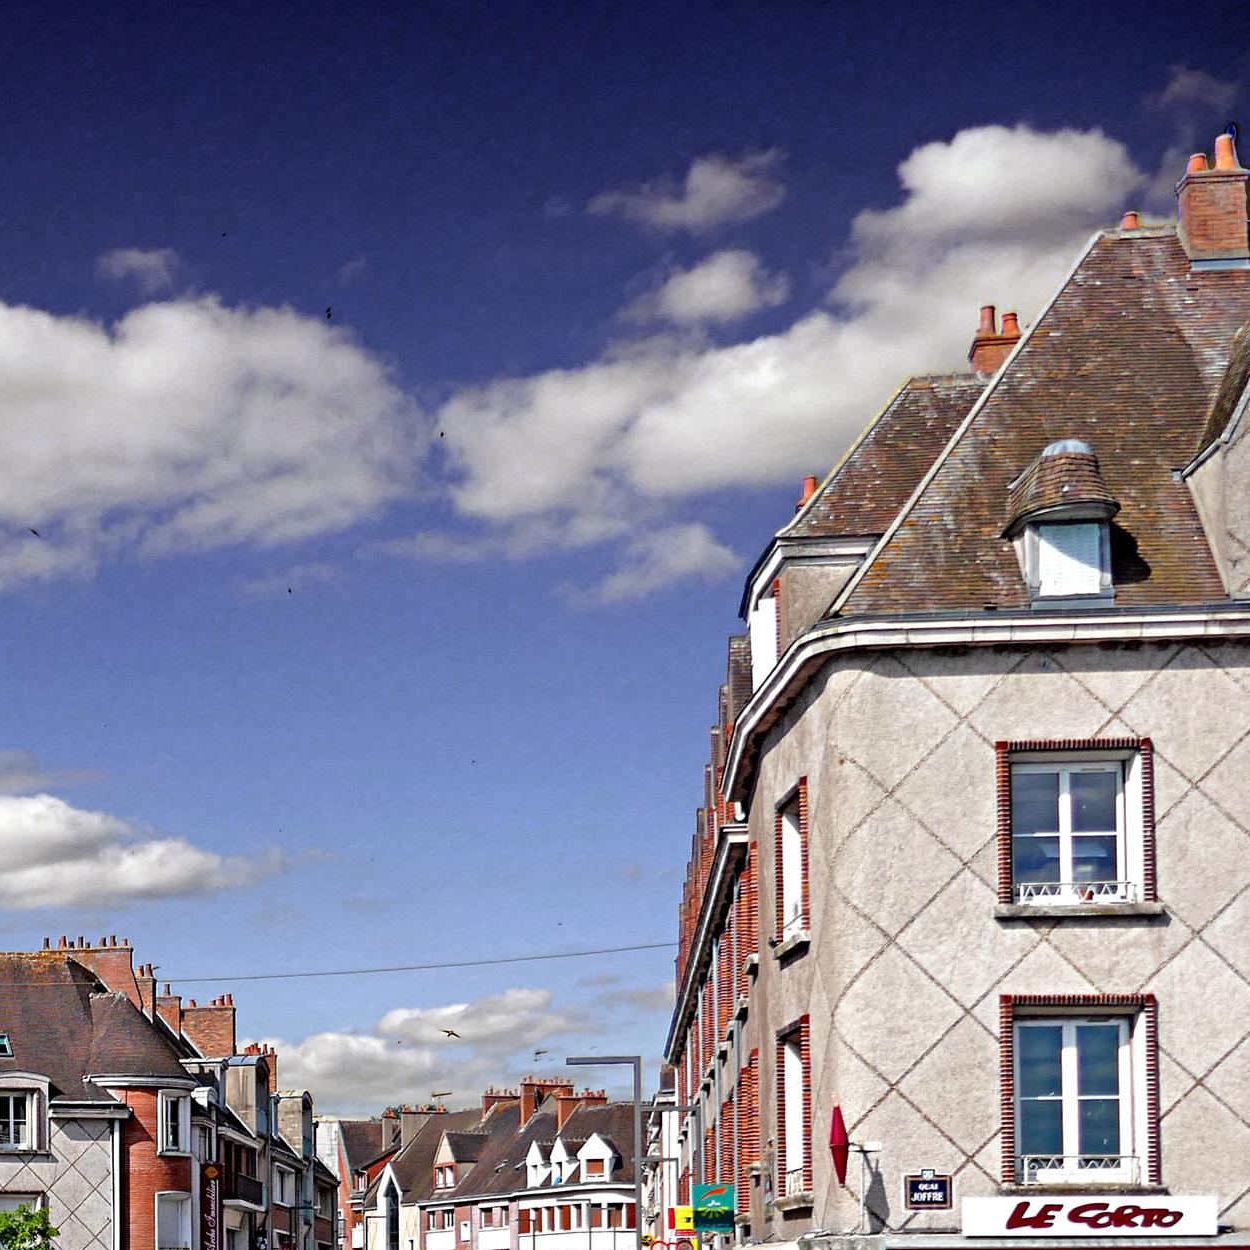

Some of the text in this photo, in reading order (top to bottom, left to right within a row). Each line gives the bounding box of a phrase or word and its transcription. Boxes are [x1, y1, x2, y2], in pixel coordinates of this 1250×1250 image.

[918, 1183, 939, 1191] QUAI
[911, 1192, 944, 1201] JOFFRE
[1006, 1201, 1064, 1230] LE
